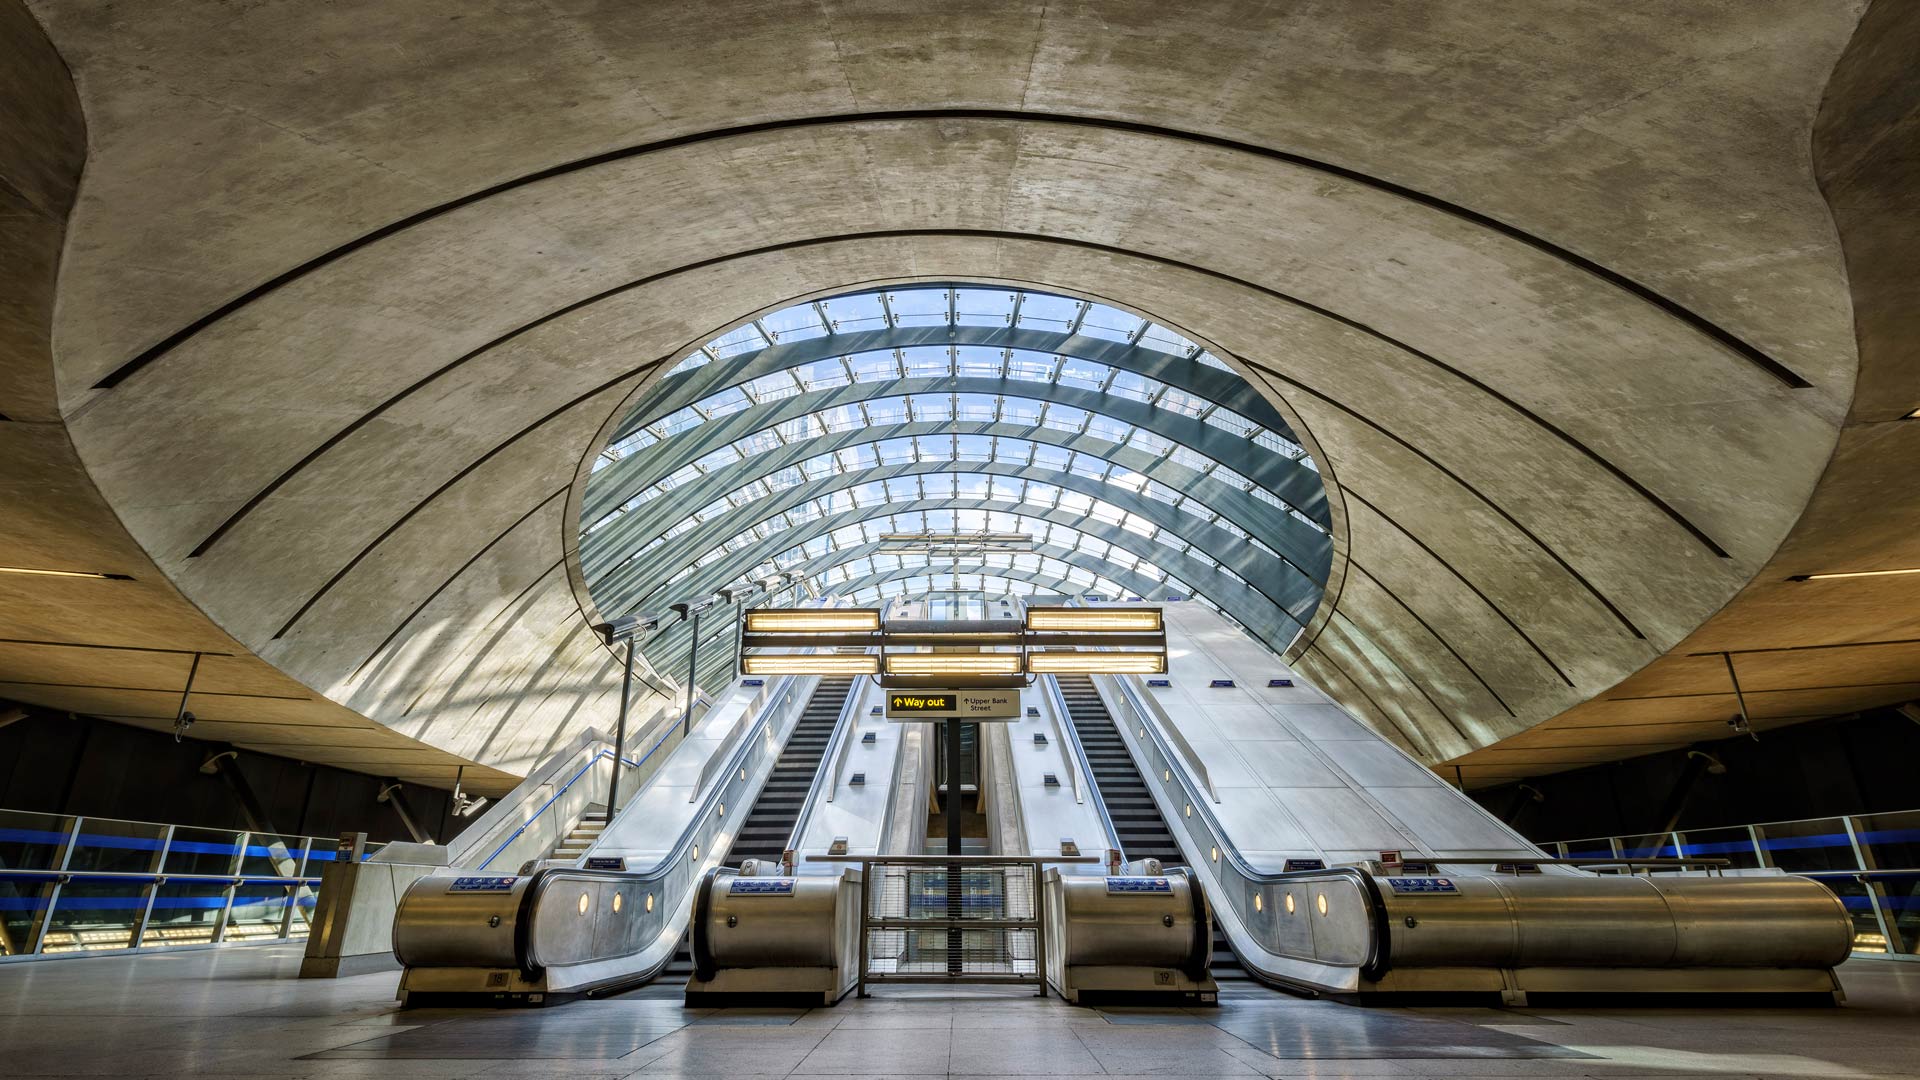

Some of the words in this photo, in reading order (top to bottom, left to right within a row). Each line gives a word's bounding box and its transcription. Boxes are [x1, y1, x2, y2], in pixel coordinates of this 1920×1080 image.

[904, 697, 925, 708] Way
[927, 698, 945, 707] out
[1159, 972, 1169, 982] 19
